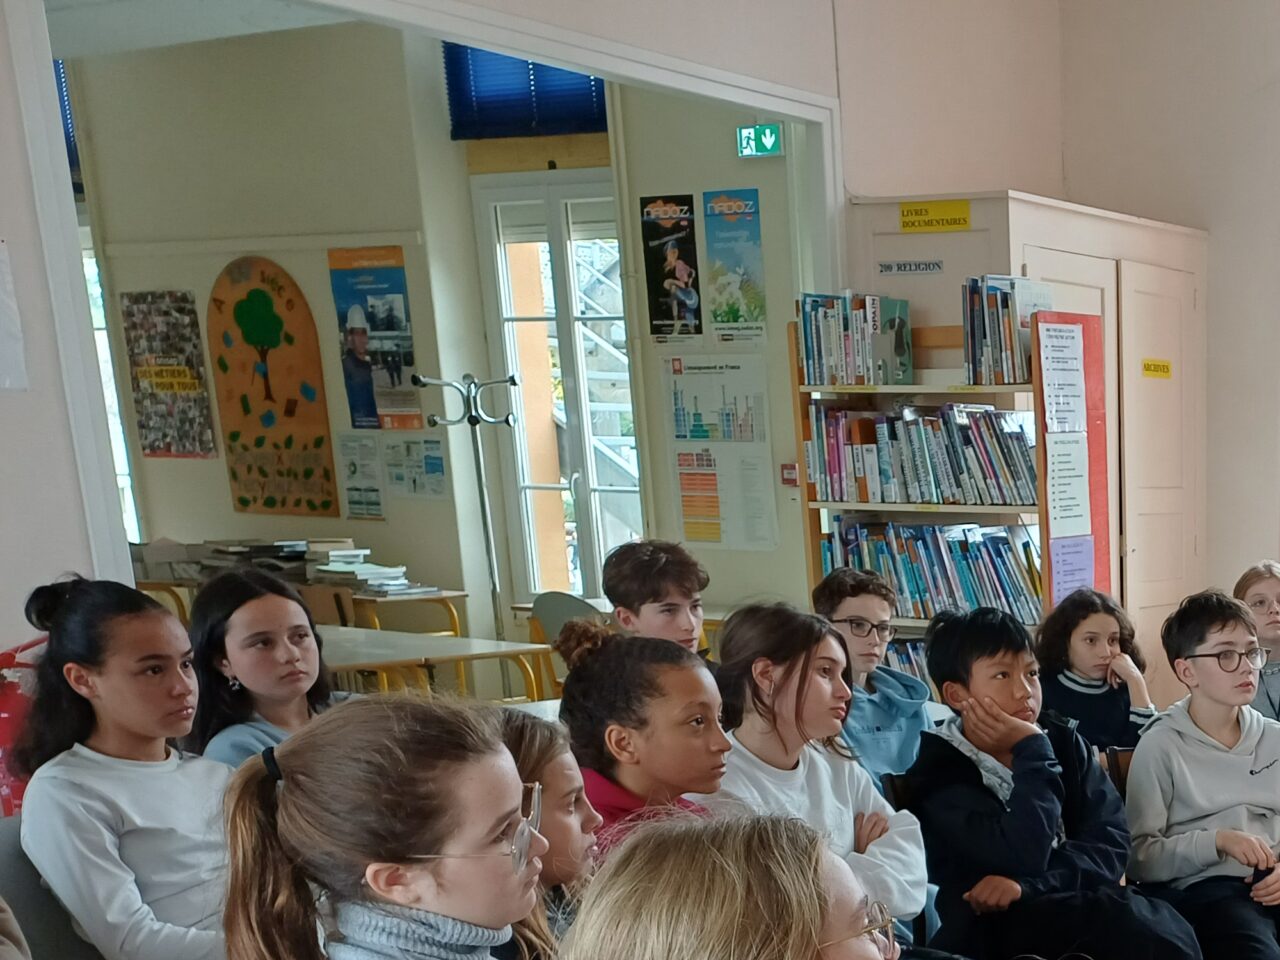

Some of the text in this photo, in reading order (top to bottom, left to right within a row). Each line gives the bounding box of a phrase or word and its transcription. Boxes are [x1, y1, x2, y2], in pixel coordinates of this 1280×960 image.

[901, 208, 928, 217] LIVRES
[902, 217, 967, 228] DOCUMENTAIRES
[879, 262, 942, 273] 200 RELIGION
